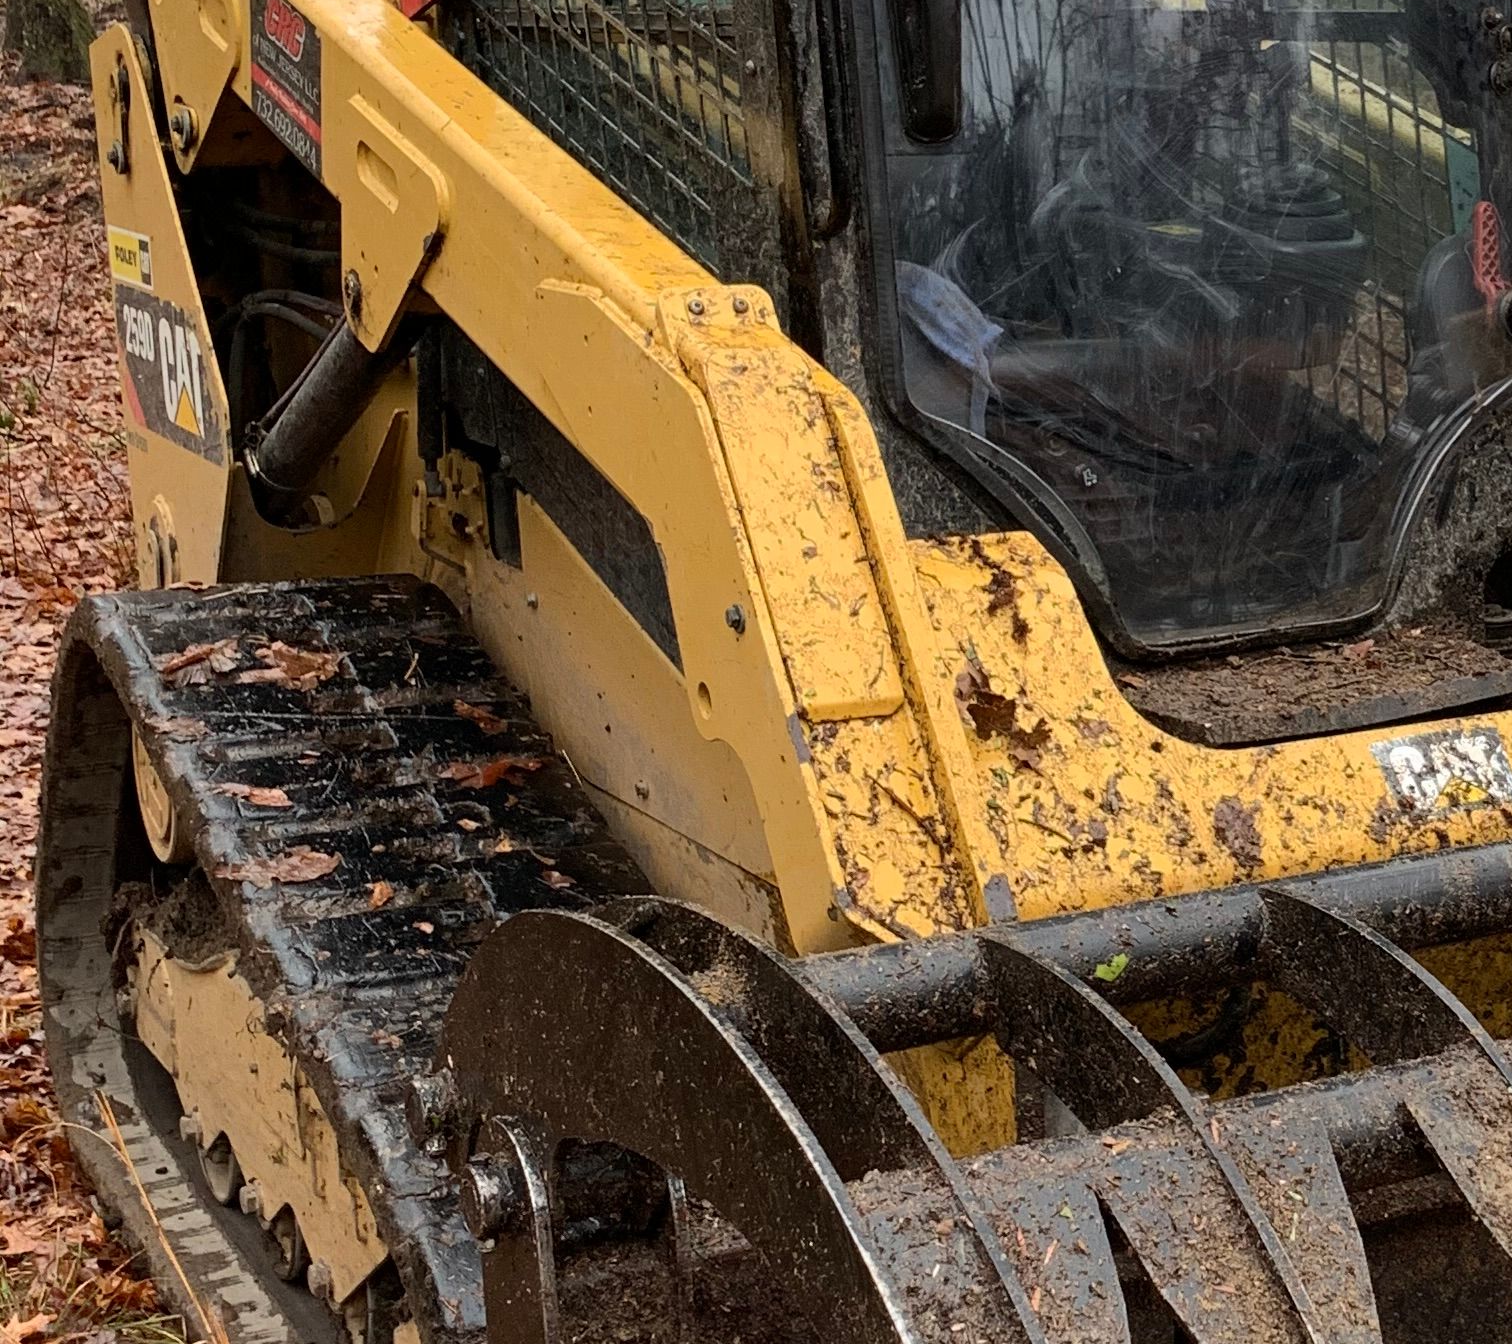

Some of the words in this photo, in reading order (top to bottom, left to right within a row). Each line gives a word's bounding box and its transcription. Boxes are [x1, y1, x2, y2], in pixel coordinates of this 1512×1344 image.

[260, 36, 276, 62] NEW
[277, 54, 304, 87] JERSEY
[305, 78, 319, 106] LLC
[114, 244, 137, 268] FOLEY
[122, 304, 155, 362] 259D
[158, 317, 204, 439] CAT
[1389, 735, 1508, 811] CAT
